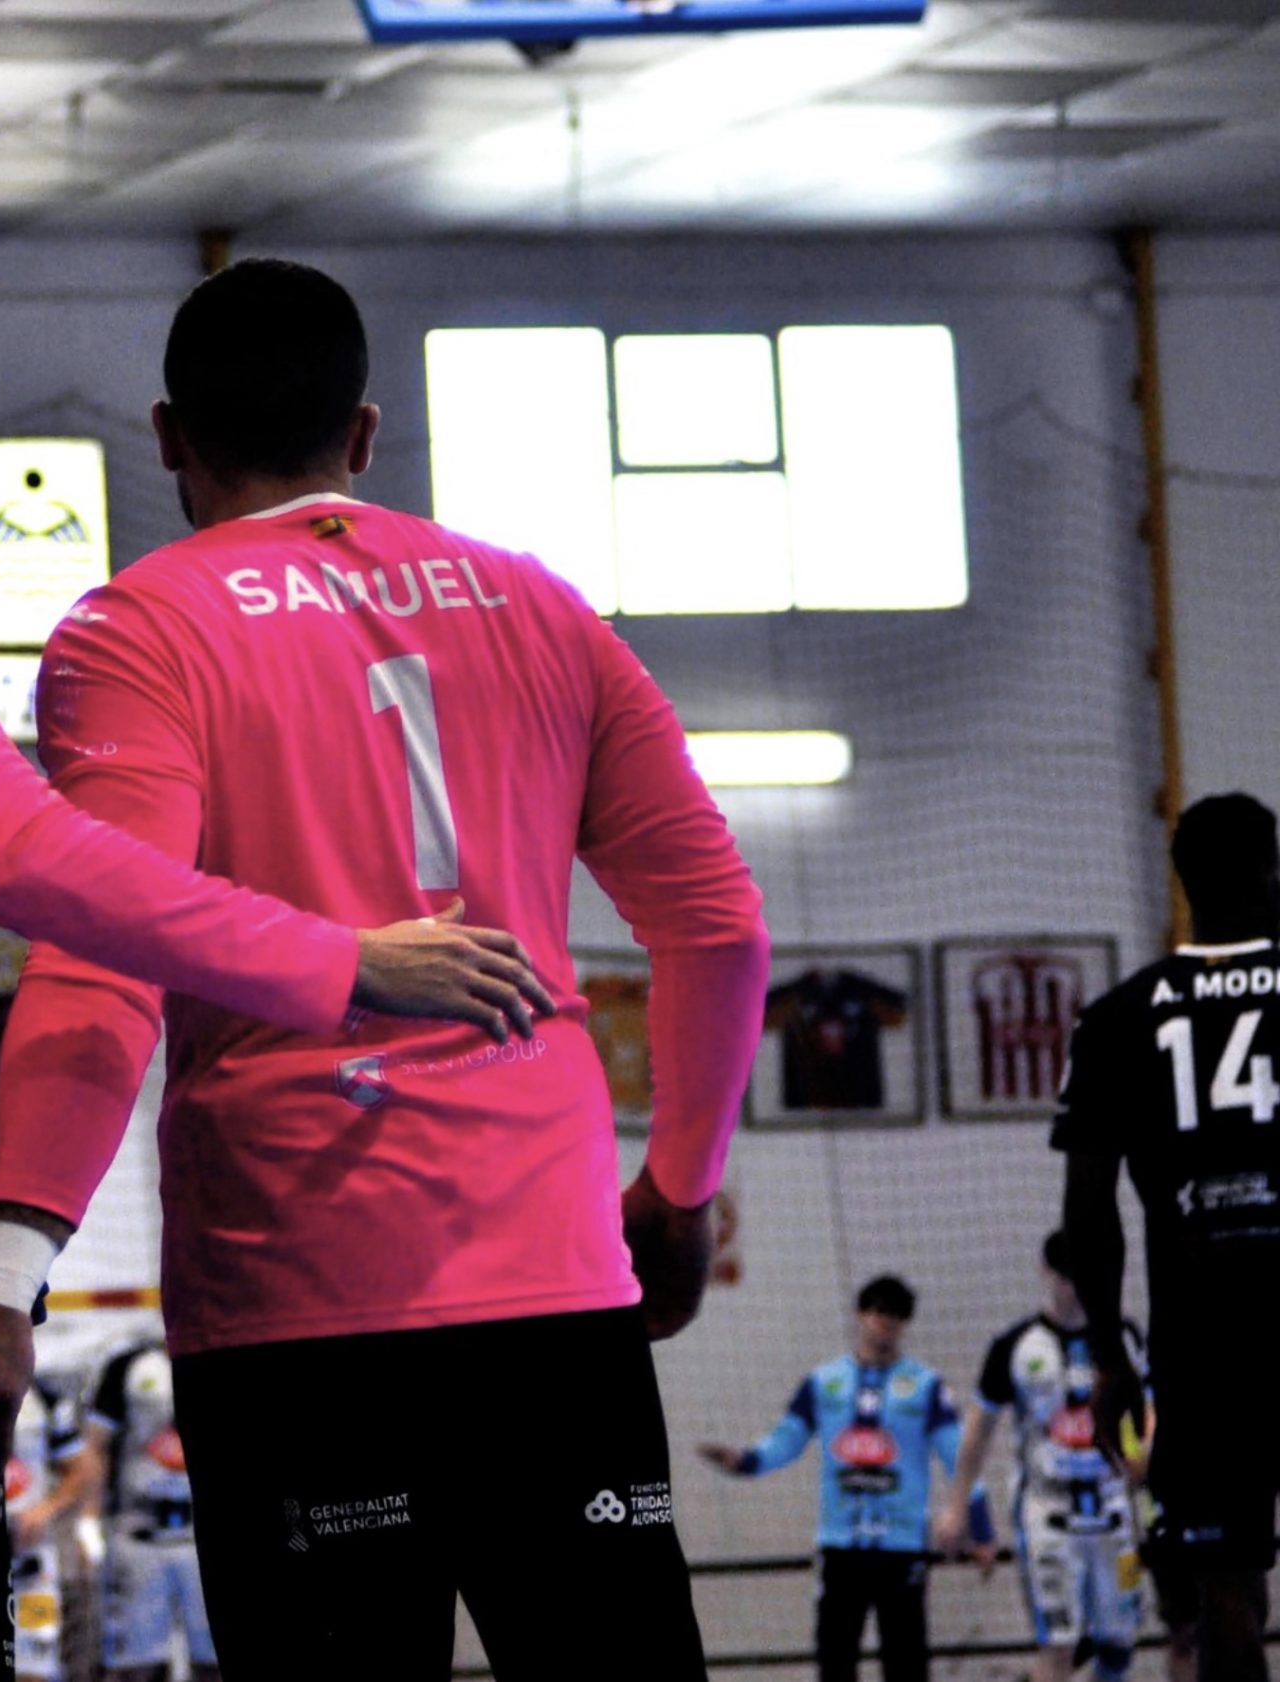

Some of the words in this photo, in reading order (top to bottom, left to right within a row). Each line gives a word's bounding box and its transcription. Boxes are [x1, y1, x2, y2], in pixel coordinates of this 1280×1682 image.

[227, 558, 507, 617] SAMUEL
[367, 654, 459, 890] 1
[1194, 966, 1280, 1000] MOD
[1156, 1009, 1280, 1131] 14
[308, 1492, 410, 1521] GENERALITAT
[312, 1510, 412, 1536] VALENCIANA
